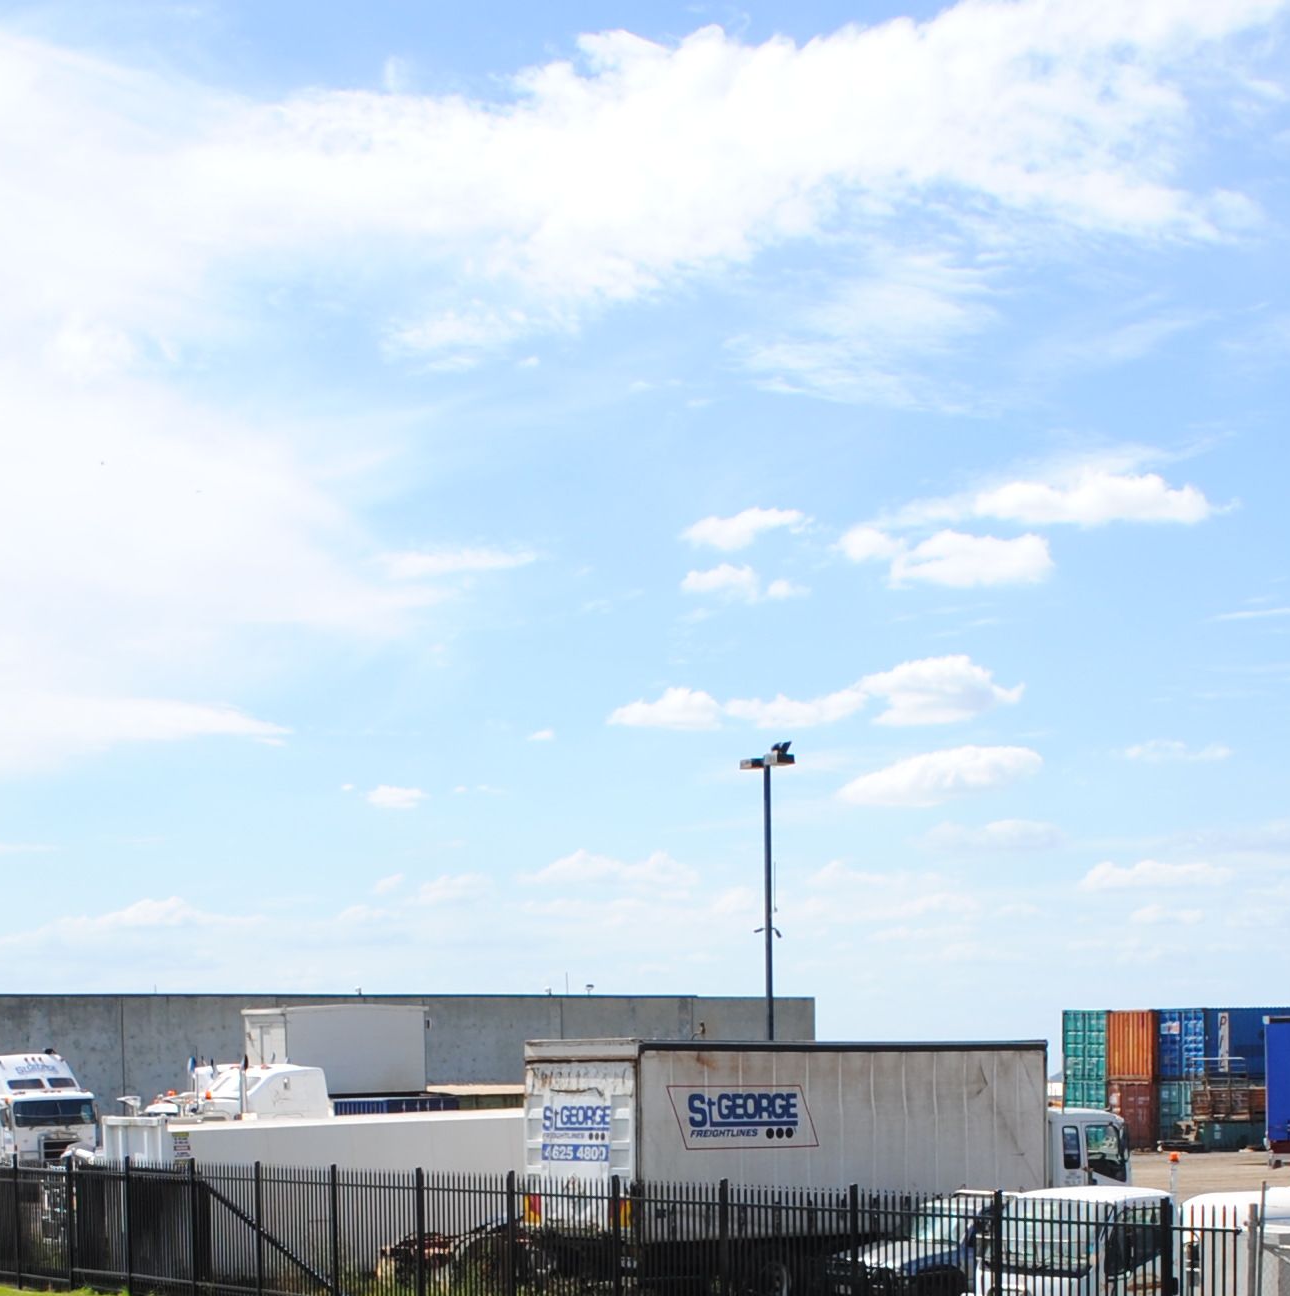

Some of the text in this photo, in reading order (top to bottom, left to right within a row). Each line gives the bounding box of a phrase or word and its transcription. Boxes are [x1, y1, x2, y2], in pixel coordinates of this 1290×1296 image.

[542, 1105, 611, 1131] St GEORGE
[687, 1093, 798, 1128] St GEORGE
[690, 1128, 758, 1138] FREIGHTLINES
[543, 1145, 607, 1160] 4625 4800
